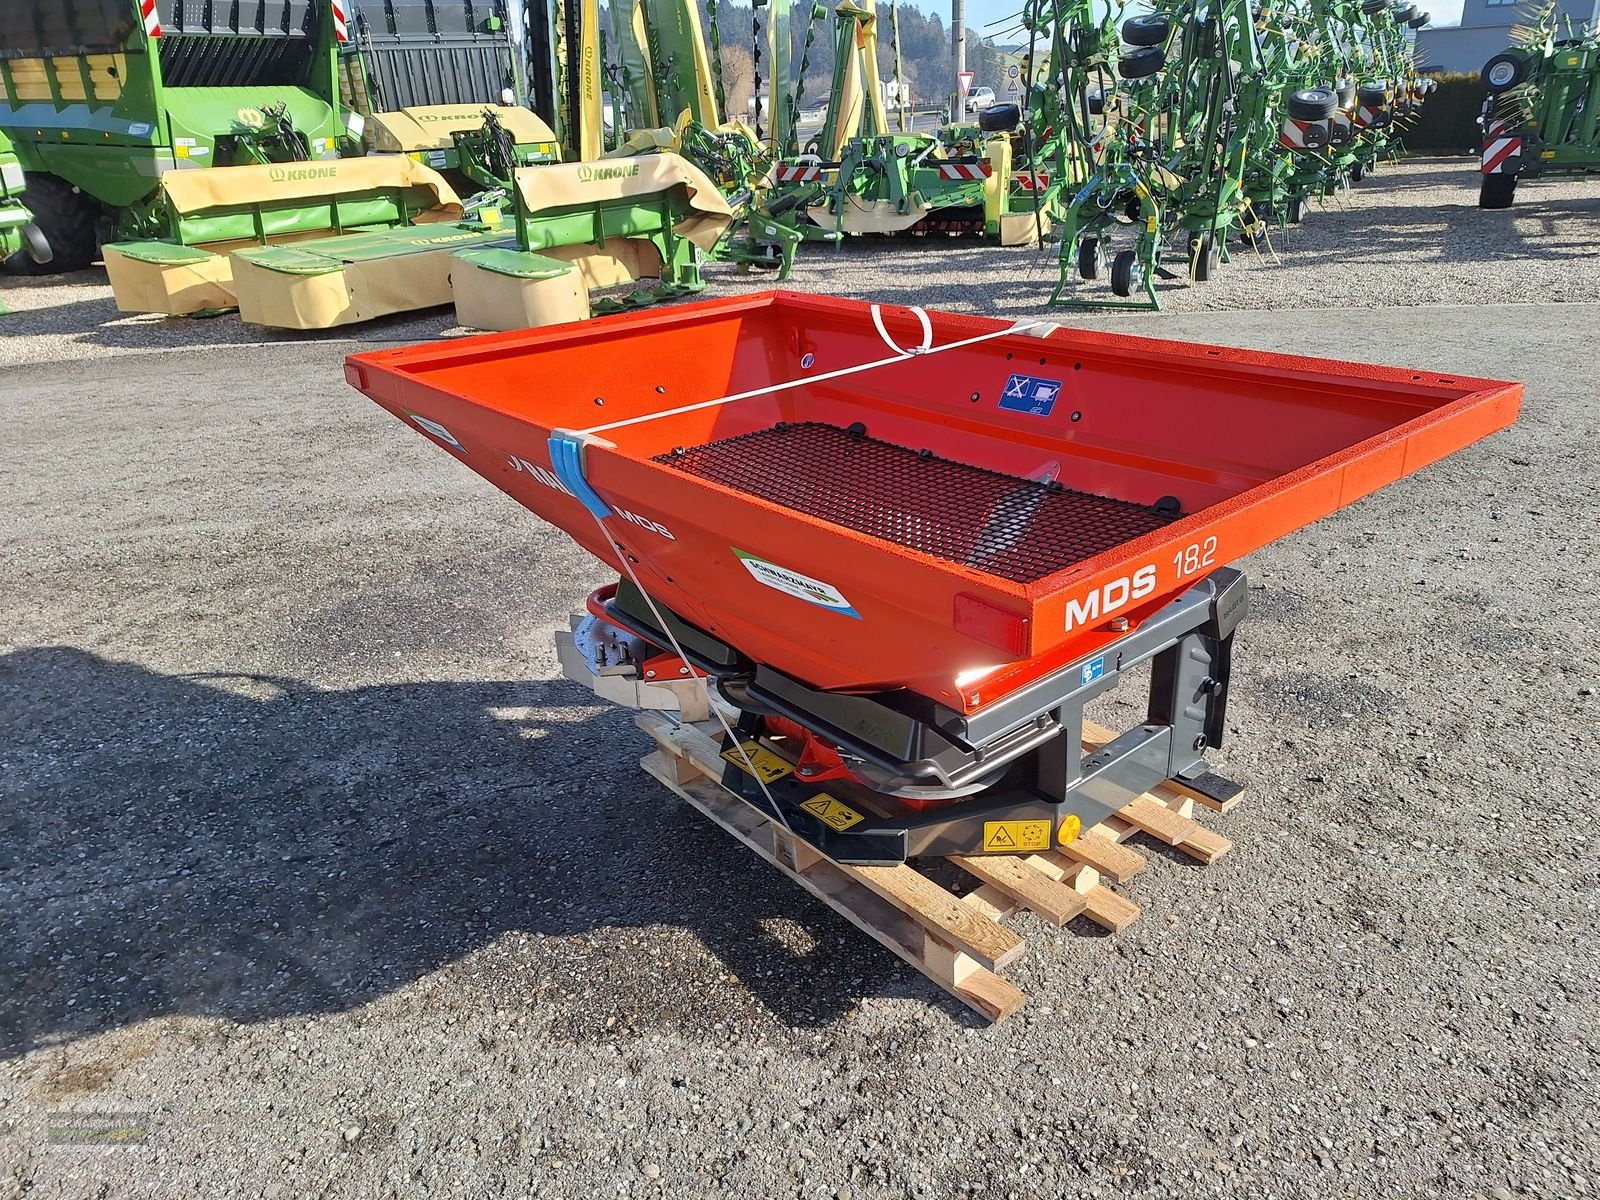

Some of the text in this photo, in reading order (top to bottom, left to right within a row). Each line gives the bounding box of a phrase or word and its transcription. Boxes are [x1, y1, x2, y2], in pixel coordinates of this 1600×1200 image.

[585, 59, 593, 101] KRONE
[287, 167, 337, 181] KRONE
[593, 164, 640, 181] KRONE
[430, 231, 483, 244] KRONE
[612, 504, 676, 540] MDS
[749, 560, 828, 595] SCHWARZMAYR
[1065, 535, 1217, 632] MDS 18.2
